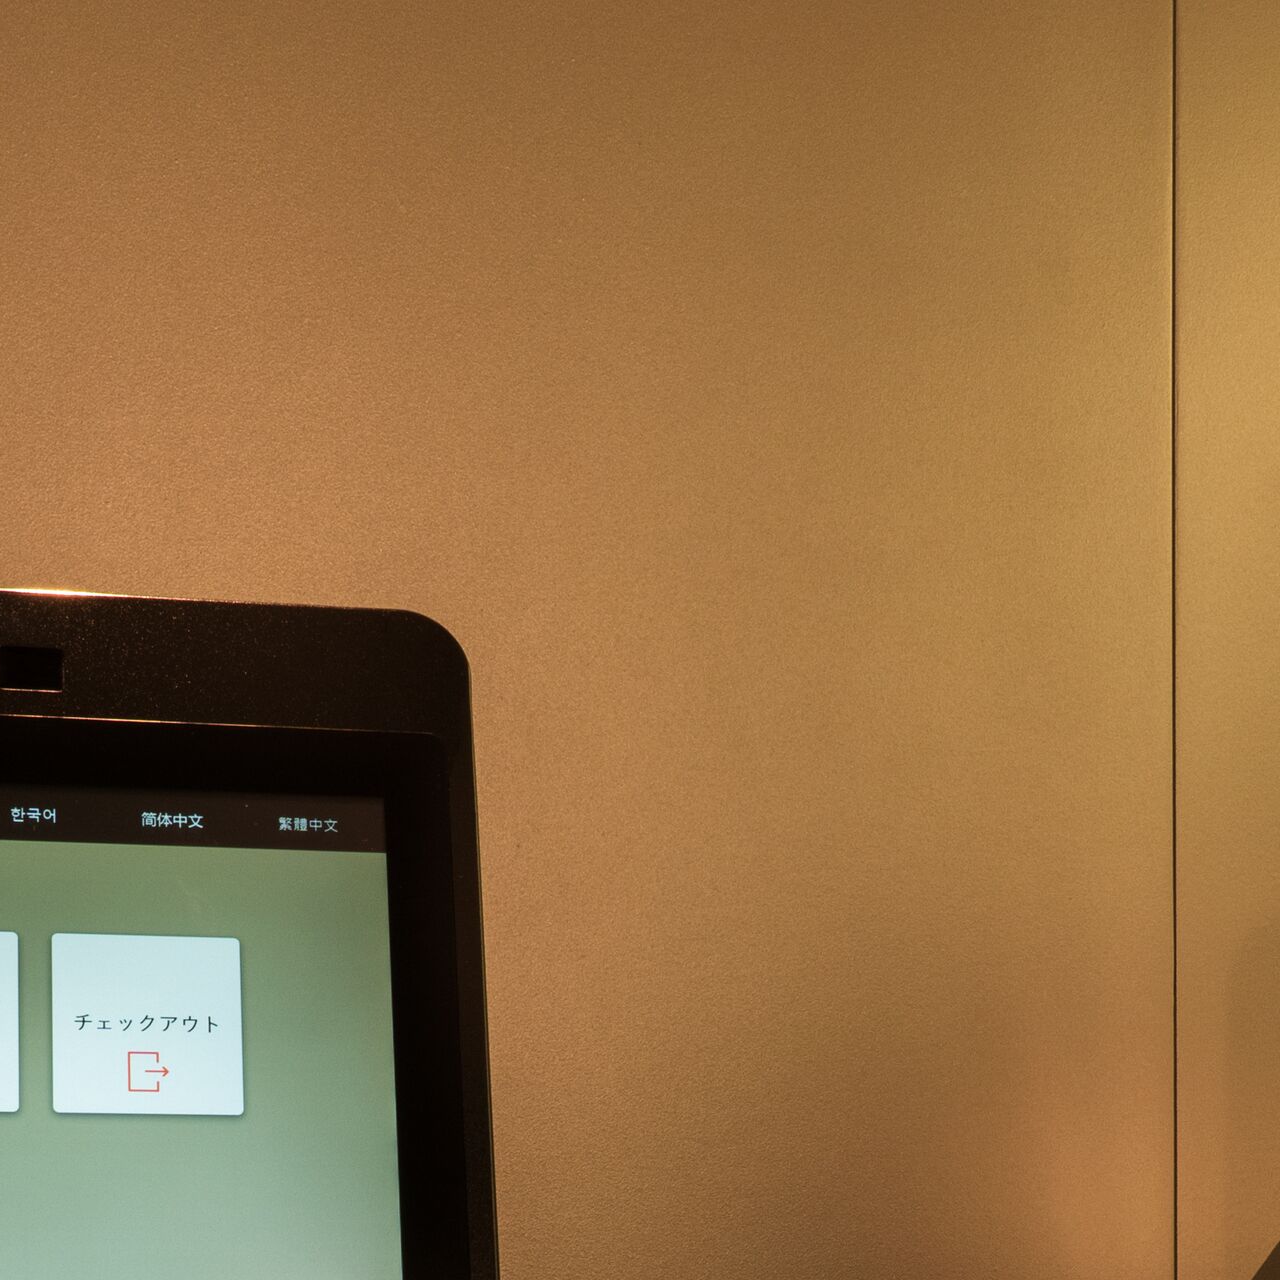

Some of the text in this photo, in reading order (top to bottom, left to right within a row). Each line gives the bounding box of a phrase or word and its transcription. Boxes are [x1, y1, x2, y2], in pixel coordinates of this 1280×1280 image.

[10, 807, 57, 823] 한국어
[141, 812, 204, 829] 简体中文
[278, 817, 338, 833] 繁體中文
[73, 1013, 219, 1034] チェックアウト
